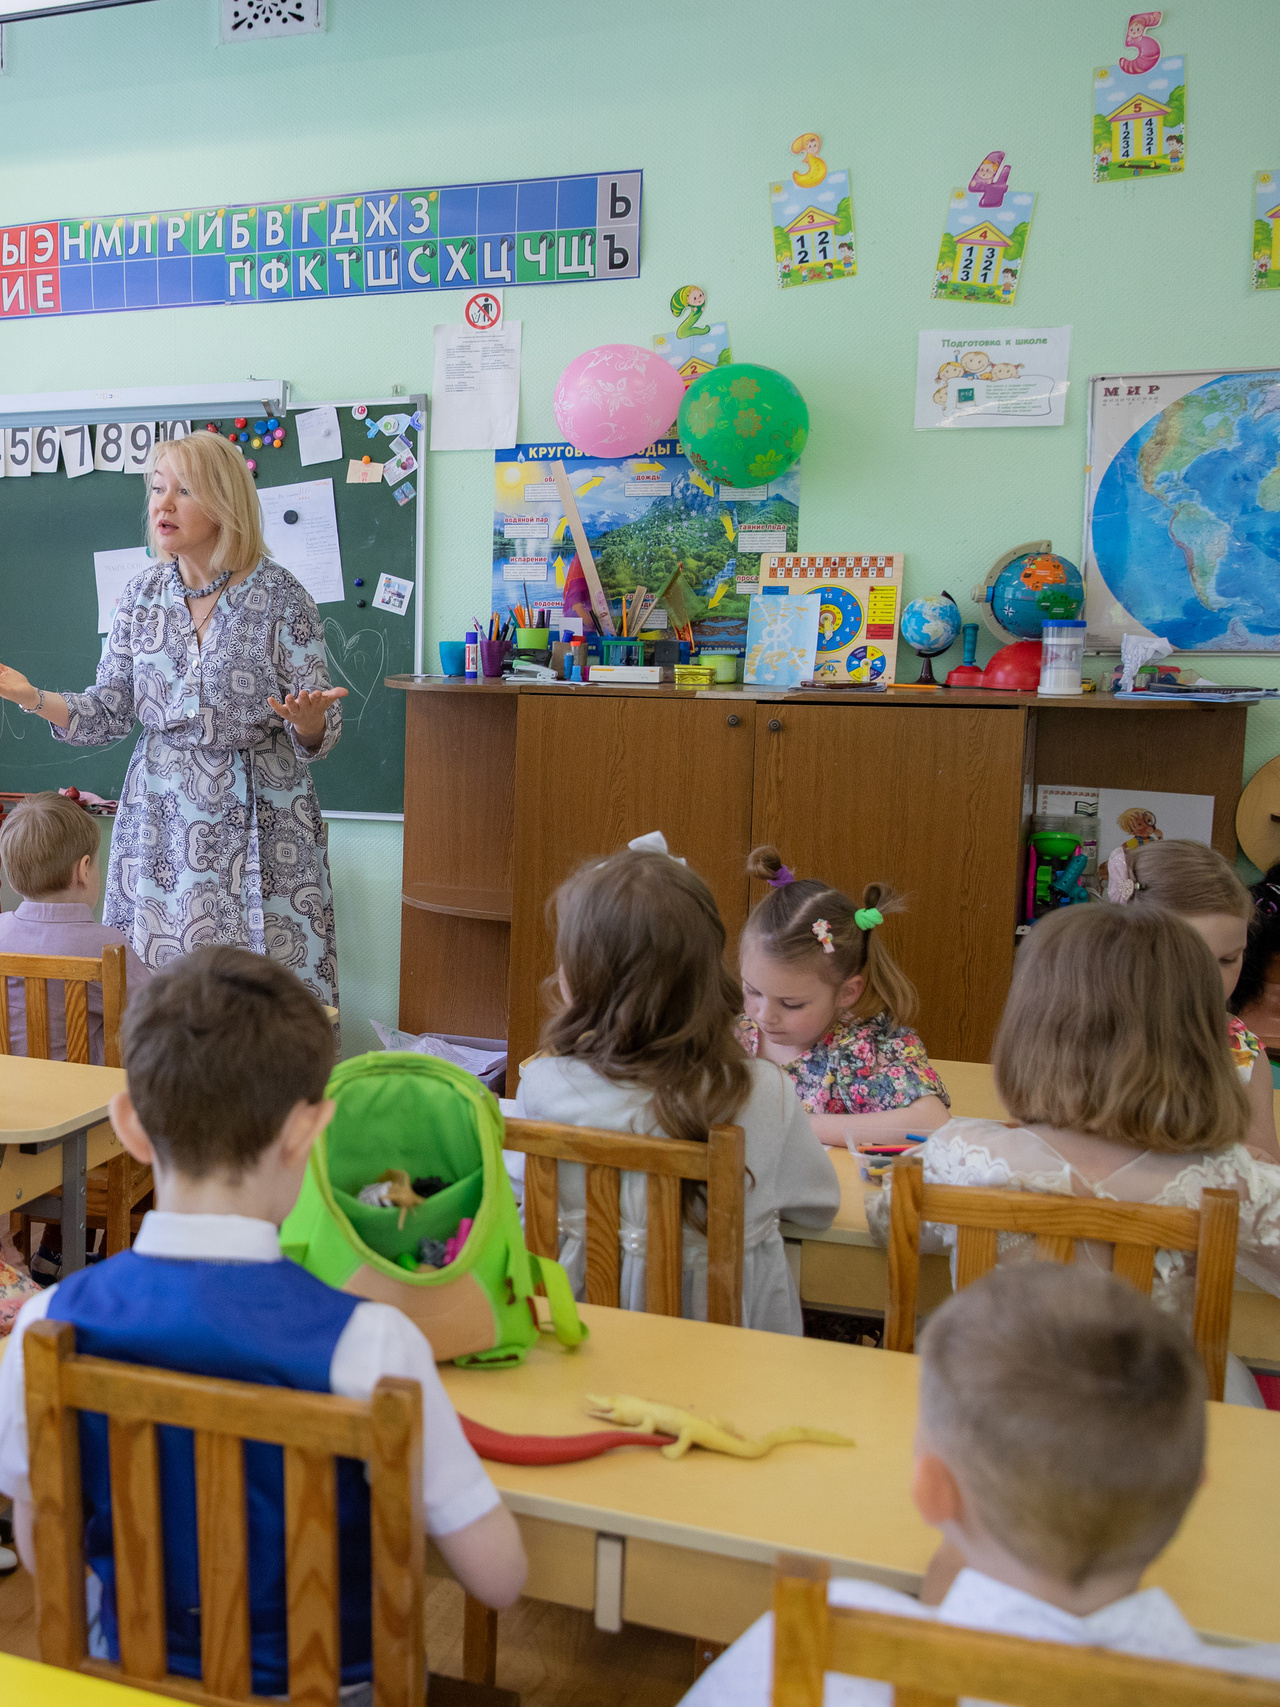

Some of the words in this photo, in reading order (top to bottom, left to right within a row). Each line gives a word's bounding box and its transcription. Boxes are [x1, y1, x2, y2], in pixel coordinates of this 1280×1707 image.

[1119, 11, 1162, 75] 5
[1134, 103, 1142, 112] 5
[1122, 122, 1128, 130] 1
[1146, 118, 1153, 127] 4
[1122, 131, 1130, 140] 2
[1146, 128, 1154, 136] 3
[1122, 140, 1130, 149] 3
[1146, 137, 1154, 146] 2
[1122, 150, 1130, 158] 4
[1146, 147, 1152, 155] 1
[790, 132, 828, 188] 3
[968, 151, 1011, 208] 4
[2, 230, 26, 266] Ы
[34, 228, 54, 264] Э
[64, 225, 86, 260] Н
[93, 222, 122, 258] М
[128, 220, 152, 255] Л
[167, 216, 186, 252] Р
[198, 210, 223, 250] Й
[232, 213, 250, 249] Б
[266, 210, 284, 246] В
[302, 206, 320, 243] Г
[330, 202, 359, 246] Д
[366, 200, 399, 238] Ж
[408, 196, 430, 234] З
[610, 181, 632, 220] Ь
[807, 214, 814, 224] 3
[796, 236, 805, 250] 1
[817, 231, 830, 246] 2
[979, 230, 988, 240] 4
[798, 250, 810, 264] 2
[820, 246, 828, 260] 1
[966, 246, 974, 258] 1
[986, 248, 995, 259] 3
[962, 258, 973, 270] 2
[982, 260, 993, 271] 2
[2, 276, 26, 312] И
[36, 274, 54, 309] Е
[229, 260, 251, 296] П
[260, 258, 289, 294] Ф
[300, 254, 323, 292] К
[336, 252, 356, 288] Т
[367, 249, 399, 286] Ш
[408, 246, 431, 284] С
[444, 244, 472, 282] Х
[484, 240, 512, 282] Ц
[524, 236, 547, 276] Ч
[558, 234, 595, 277] Щ
[602, 234, 630, 271] Ъ
[960, 270, 970, 282] 3
[980, 272, 988, 283] 1
[670, 286, 710, 339] 2
[942, 339, 1000, 348] Подготовка
[690, 366, 698, 374] 2
[10, 427, 30, 466] 5
[36, 426, 57, 464] 6
[64, 425, 85, 467] 7
[101, 423, 121, 462] 8
[130, 424, 152, 464] 9
